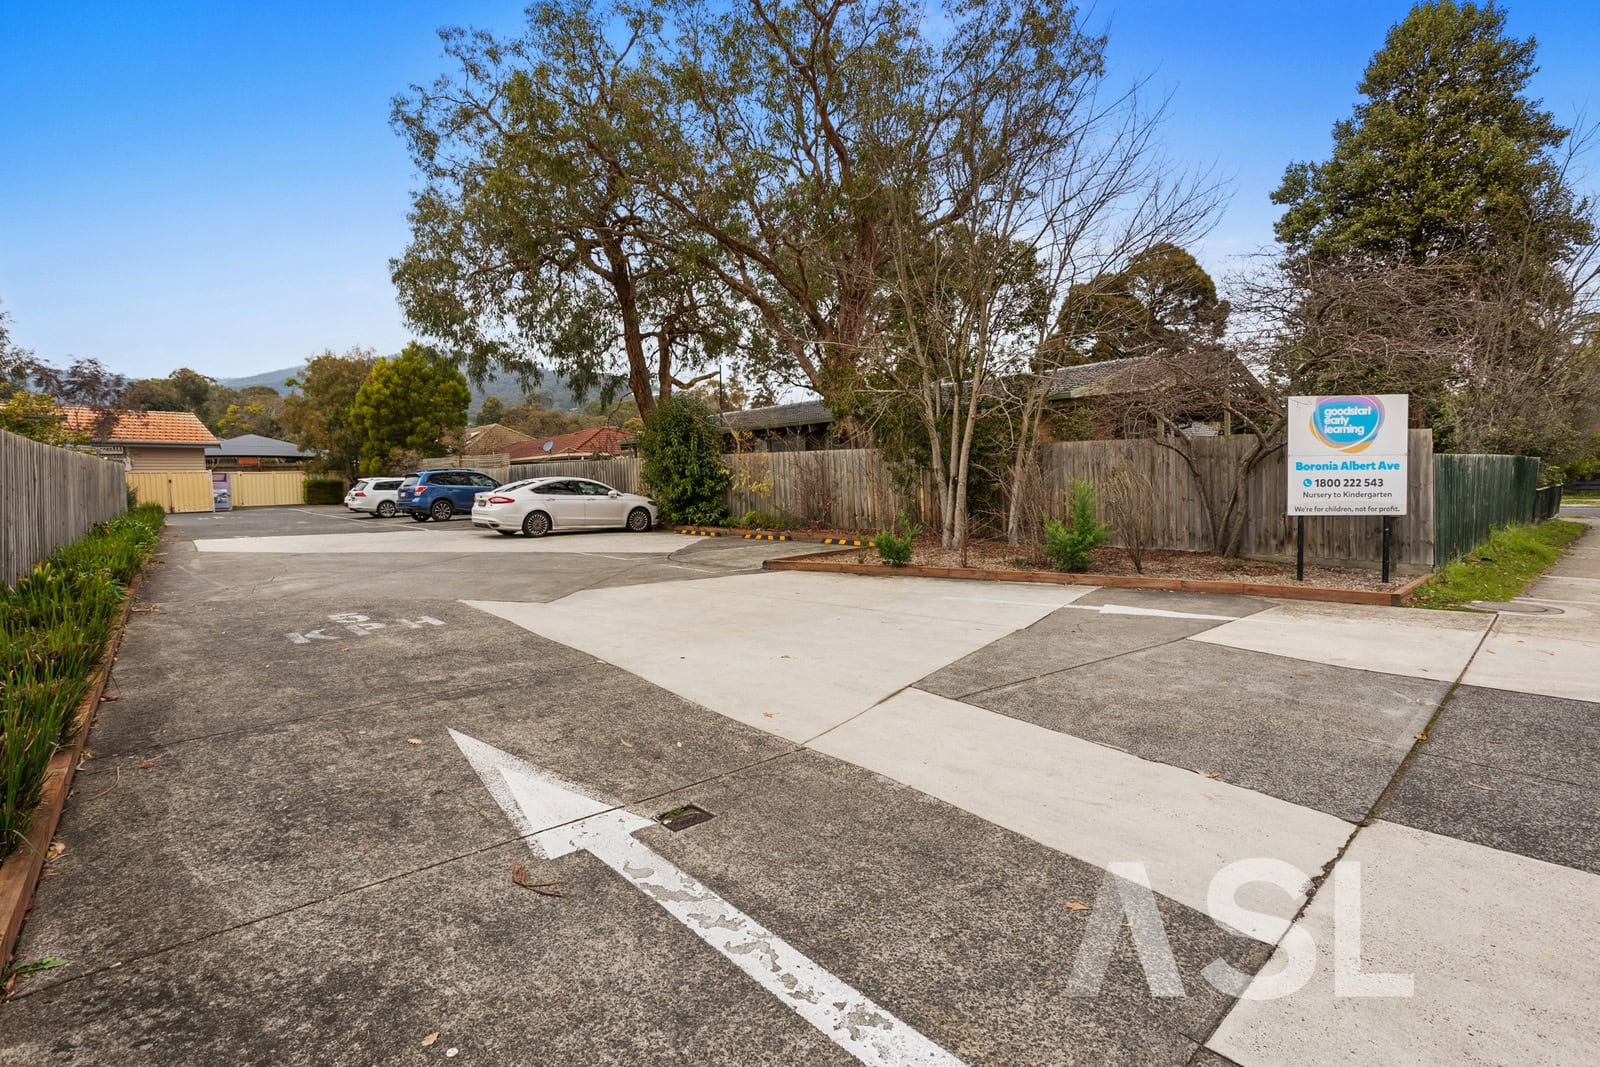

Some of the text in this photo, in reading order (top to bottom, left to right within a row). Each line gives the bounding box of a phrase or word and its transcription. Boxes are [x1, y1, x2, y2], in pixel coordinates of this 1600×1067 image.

[1324, 406, 1372, 418] goodstart
[1324, 415, 1350, 426] early
[1324, 425, 1365, 436] learning
[1295, 460, 1400, 471] Boronia Albert Ave
[1314, 478, 1384, 488] 1800 222 543
[1302, 491, 1332, 499] Nursery
[1343, 491, 1393, 499] Kindergarten
